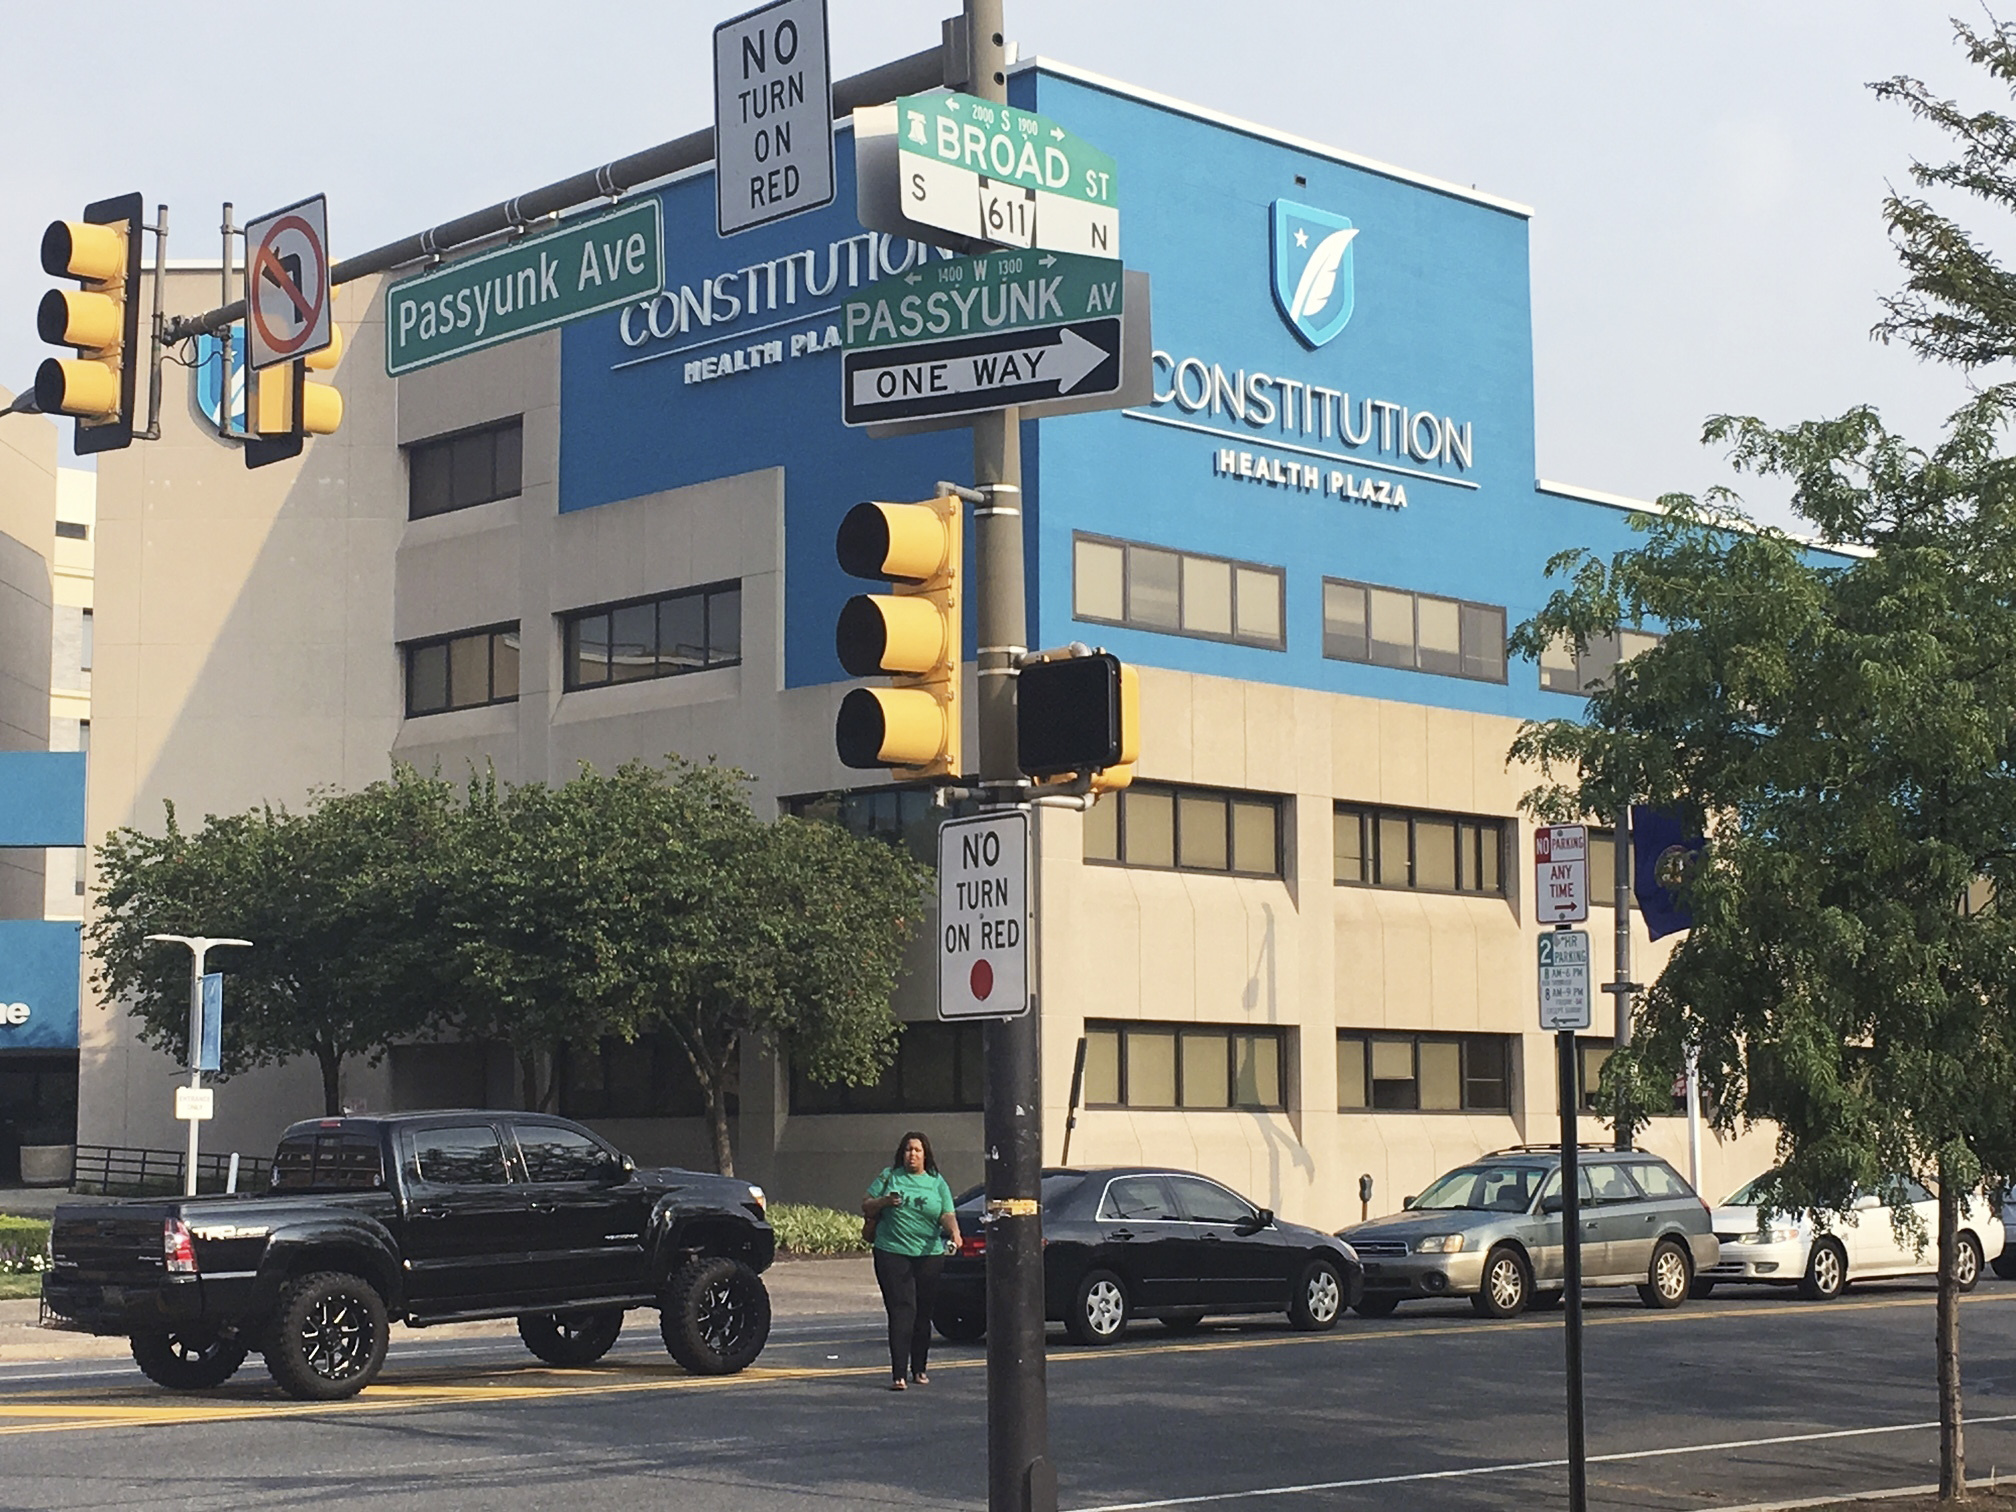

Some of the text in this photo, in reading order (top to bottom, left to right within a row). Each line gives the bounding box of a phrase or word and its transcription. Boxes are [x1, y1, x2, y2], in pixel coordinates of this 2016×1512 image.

[742, 19, 798, 79] NO
[738, 71, 804, 123] TURN
[972, 104, 1038, 136] 2000 S 1900
[755, 121, 791, 162] ON
[936, 115, 1110, 200] BROAD ST
[751, 165, 800, 209] RED
[912, 174, 1107, 250] S 611 N
[400, 233, 646, 348] Passyunk Ave
[938, 260, 1023, 284] 1400 W 1300
[847, 276, 1117, 344] PASSYUNK AV
[684, 341, 782, 385] HEALTH
[877, 350, 1046, 398] ONE WAY
[1151, 350, 1472, 469] CONSTITUTION
[1217, 448, 1408, 508] HEALTH PLAZA
[963, 831, 1000, 869] NO
[1537, 837, 1584, 855] NO PARKING
[1549, 882, 1574, 898] TIME
[1551, 865, 1572, 880] ANY
[956, 878, 1008, 910] TURN
[945, 919, 1019, 953] ON RED
[1540, 936, 1577, 963] 2 HR
[1555, 950, 1586, 963] PARKING
